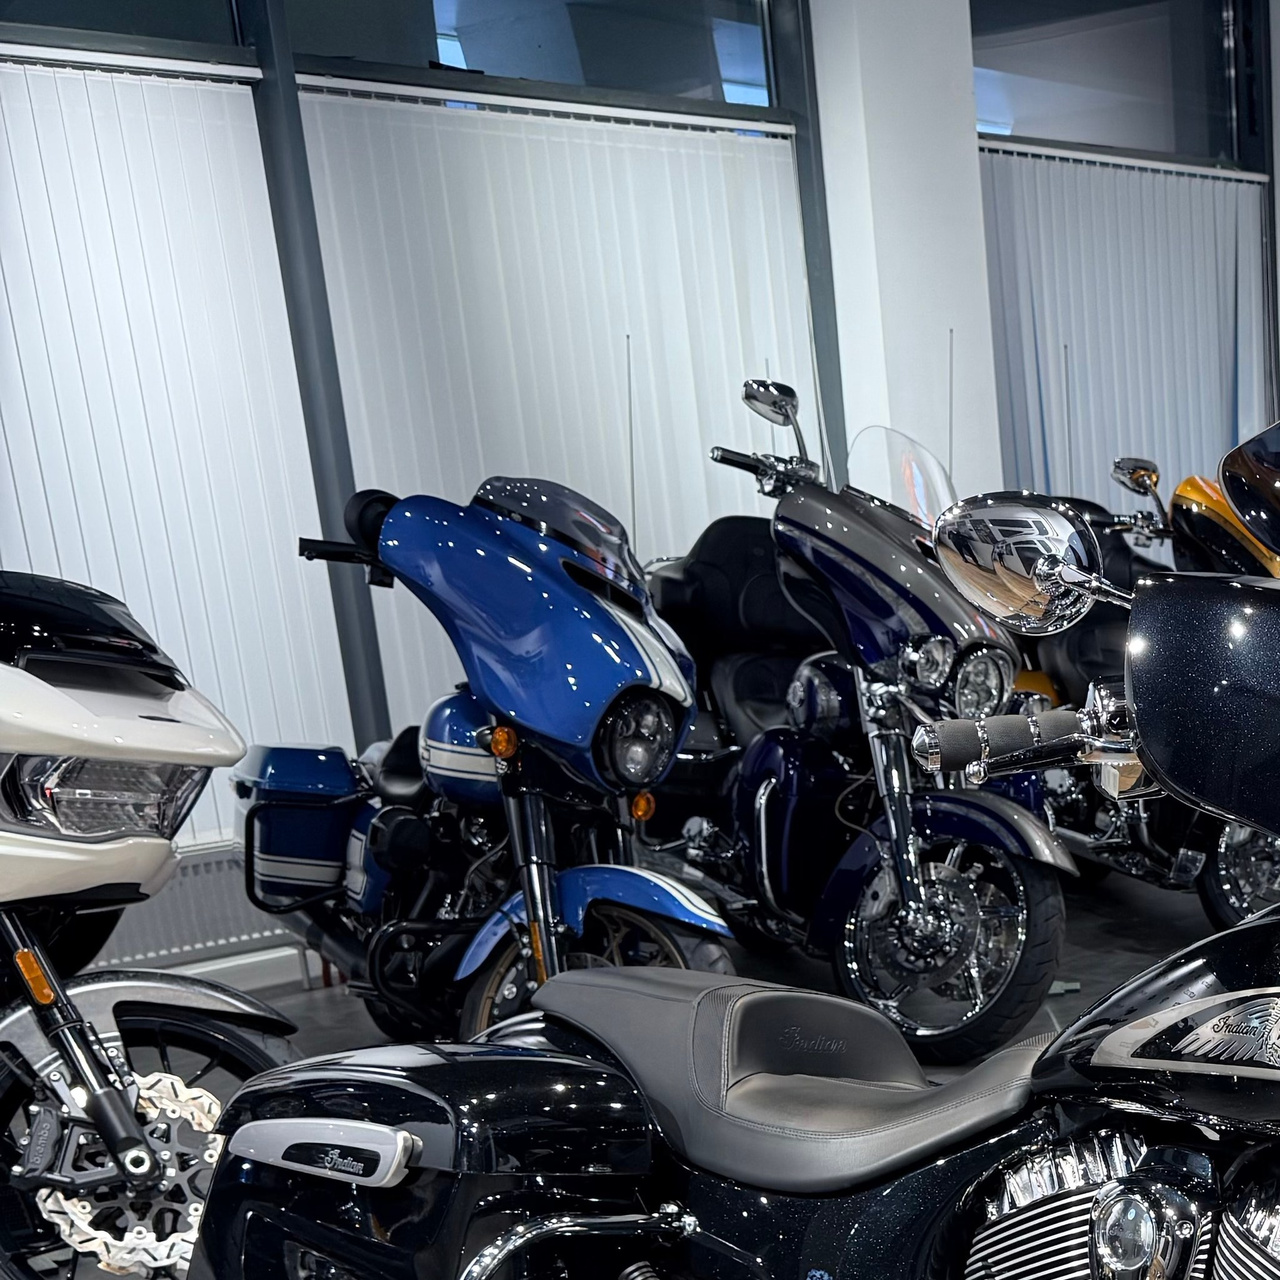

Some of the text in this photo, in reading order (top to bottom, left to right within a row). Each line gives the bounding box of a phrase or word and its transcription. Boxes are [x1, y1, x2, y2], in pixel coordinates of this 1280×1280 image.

[1212, 1015, 1258, 1037] Indian
[778, 1026, 847, 1054] Indian
[30, 1122, 51, 1165] brembo
[324, 1149, 365, 1174] Indian
